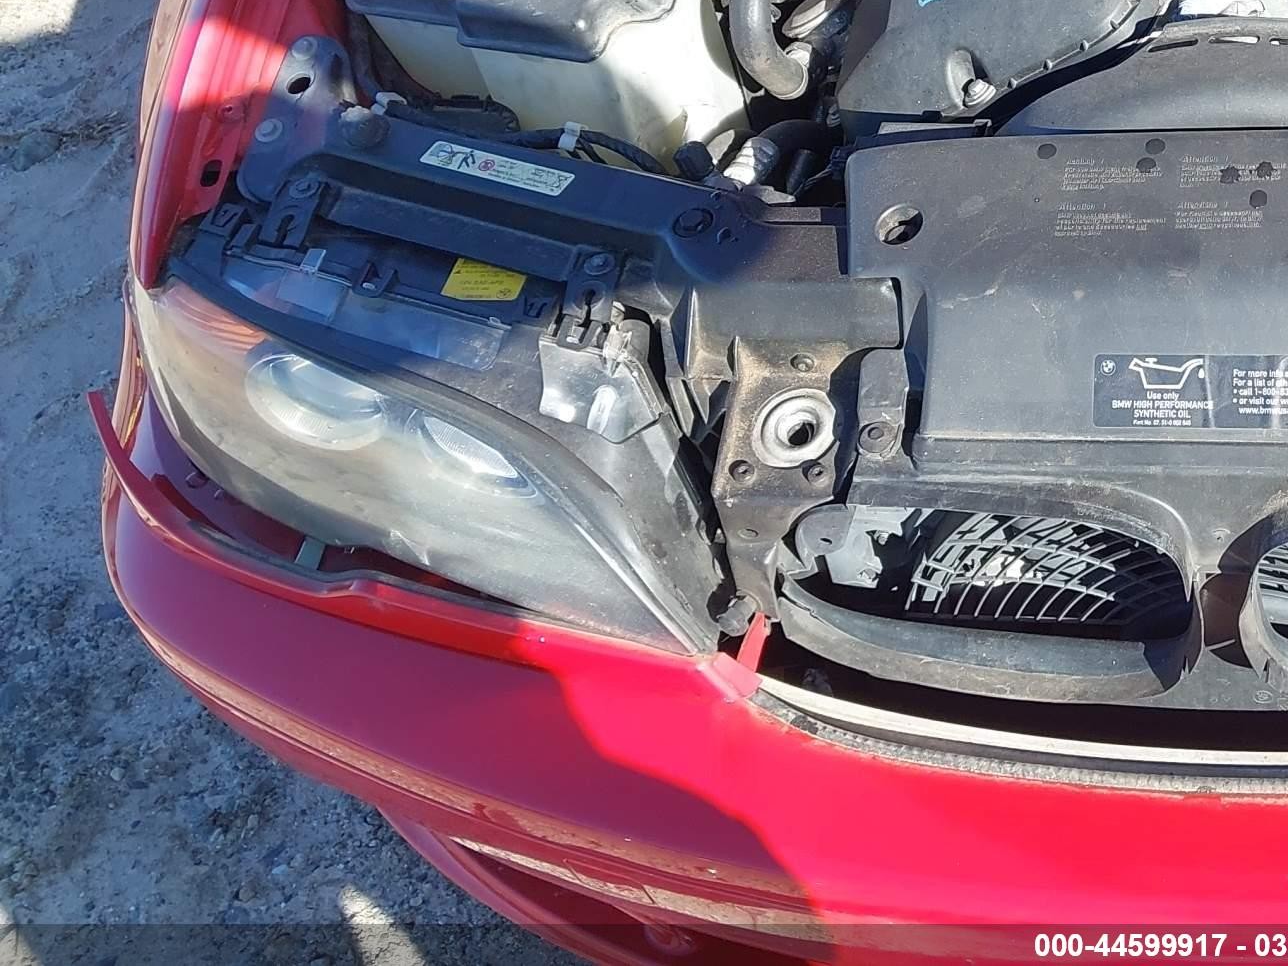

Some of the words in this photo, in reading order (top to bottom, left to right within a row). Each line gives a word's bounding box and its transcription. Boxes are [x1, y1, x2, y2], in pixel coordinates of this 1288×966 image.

[1233, 369, 1246, 378] For
[1247, 370, 1268, 378] more
[1233, 378, 1246, 387] For
[1254, 378, 1266, 387] list
[1266, 378, 1275, 387] of
[1146, 391, 1162, 399] Use
[1162, 390, 1180, 401] only
[1238, 387, 1253, 396] call
[1111, 400, 1132, 409] BMW
[1133, 400, 1153, 409] HIGH
[1154, 400, 1214, 409] PERFORMANCE
[1248, 396, 1265, 405] visit
[1134, 409, 1177, 418] SYNTHETIC
[1177, 409, 1191, 418] OIL
